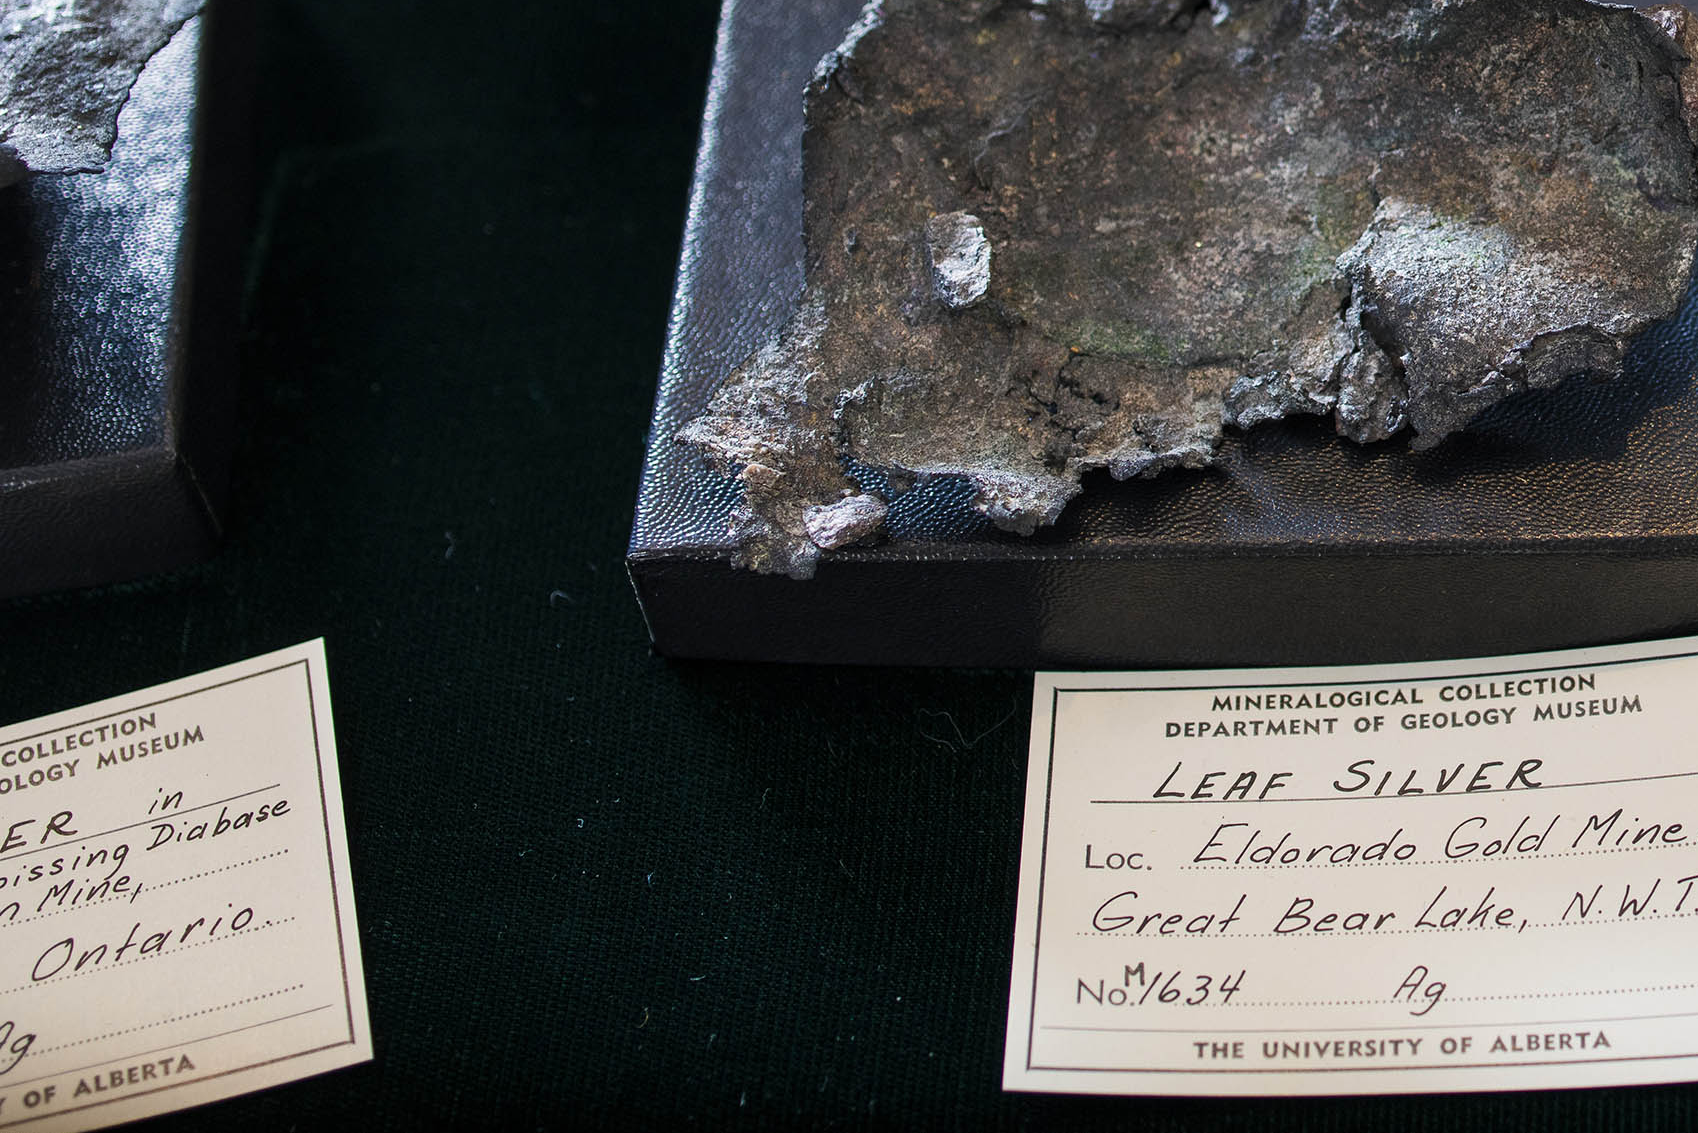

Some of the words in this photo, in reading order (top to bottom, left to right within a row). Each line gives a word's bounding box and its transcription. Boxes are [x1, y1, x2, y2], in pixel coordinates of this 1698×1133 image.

[1211, 687, 1425, 712] MINERALOGICAL
[1439, 674, 1596, 702] COLLECTION
[1, 712, 157, 767] COLLECTION
[1165, 717, 1338, 739] DEPARTMENT
[1354, 714, 1386, 733] OF
[1400, 706, 1518, 731] GEOLOGY
[1532, 695, 1642, 722] MUSEUM
[0, 758, 80, 795] OLOGY
[96, 725, 205, 770] MUSEUM
[1152, 762, 1294, 801] LEAF
[1333, 759, 1544, 794] SILVER
[148, 787, 184, 815] in
[0, 844, 130, 889] issing
[146, 797, 291, 852] Diabase
[1086, 846, 1152, 871] Loc.
[1193, 823, 1416, 865] Eldorado
[1445, 816, 1560, 859] Gold
[1572, 808, 1688, 849] Mine
[37, 871, 142, 912] Mine,
[1092, 891, 1245, 934] Great
[1274, 897, 1397, 934] Bear
[1415, 887, 1527, 934] Lake,
[1393, 966, 1447, 1016] Ag
[1195, 1040, 1244, 1059] THE
[1262, 1036, 1424, 1058] UNIVERSITY
[1440, 1035, 1475, 1055] OF
[1489, 1030, 1611, 1054] ALBERTA
[23, 1085, 57, 1109] OF
[73, 1053, 196, 1099] ALBERTA
